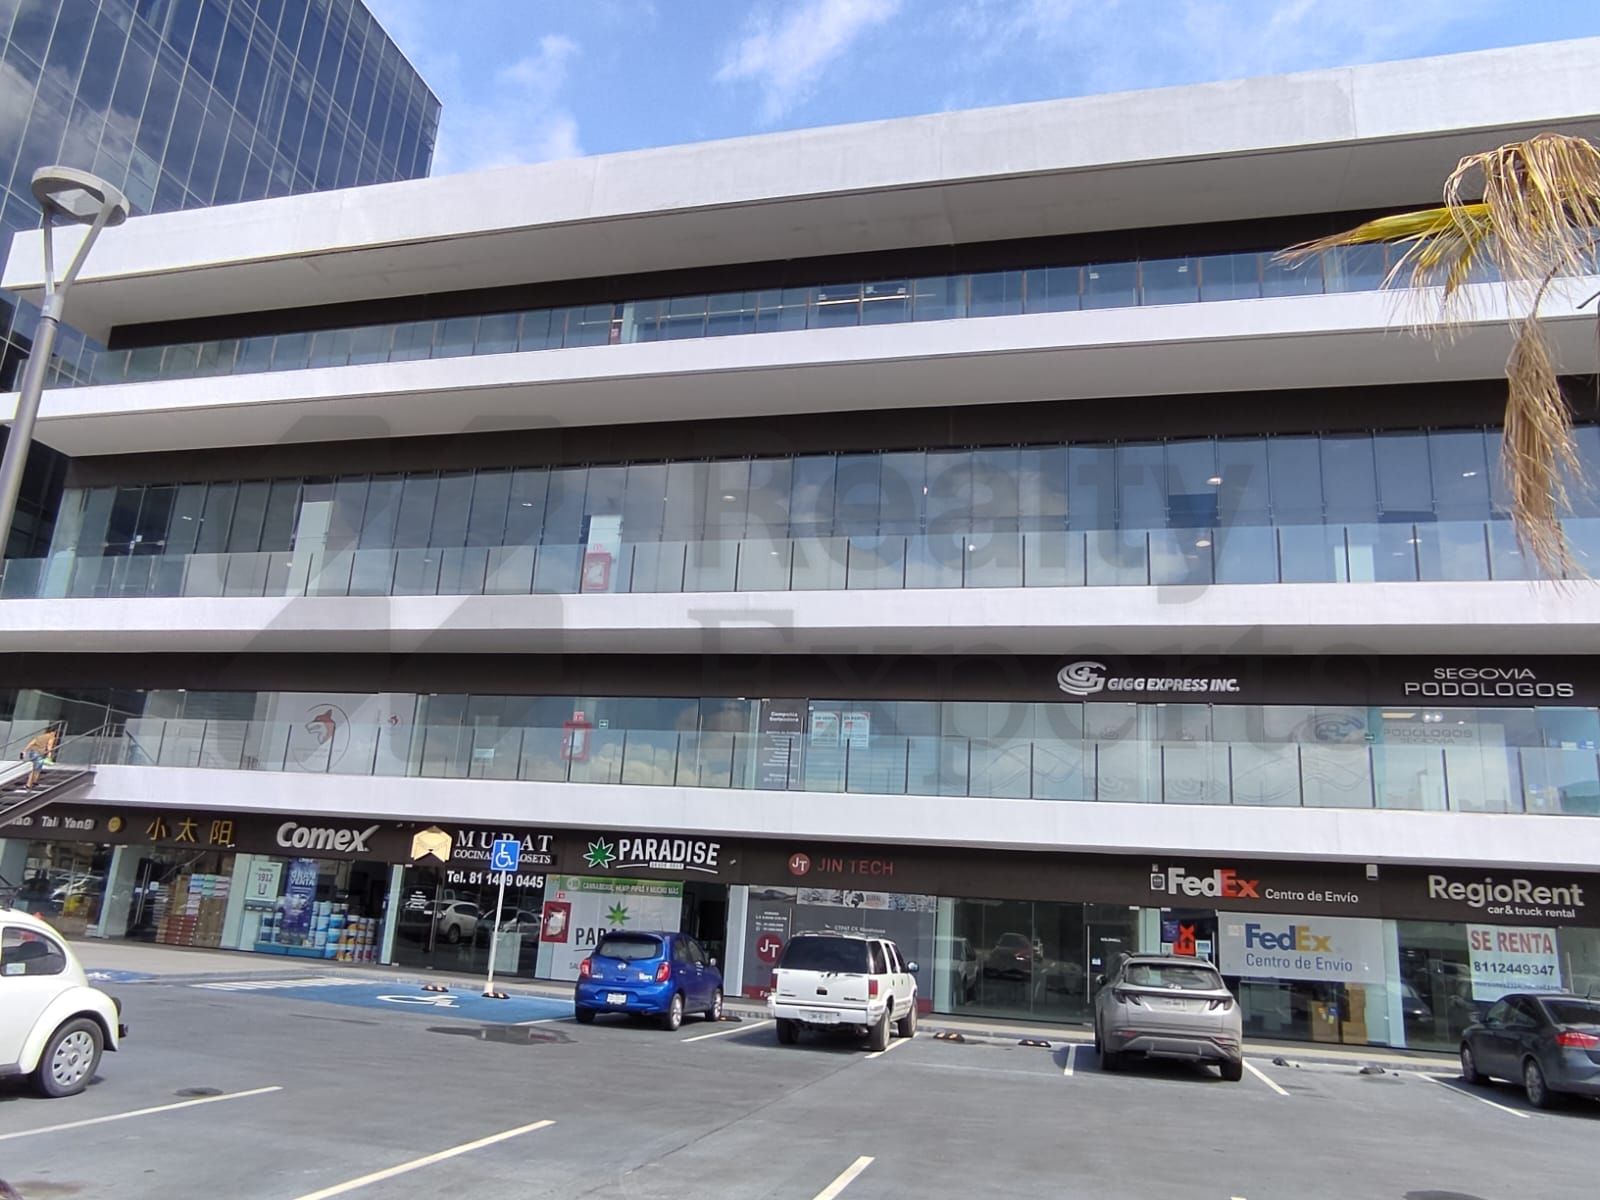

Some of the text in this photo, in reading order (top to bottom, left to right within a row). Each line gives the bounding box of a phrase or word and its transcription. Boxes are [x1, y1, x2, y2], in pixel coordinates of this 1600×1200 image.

[1433, 668, 1536, 680] SEGOVIA
[1107, 677, 1240, 692] GIGG EXPRESS INC.
[1404, 682, 1575, 697] PODOLOGOS
[42, 816, 60, 827] Tai
[65, 816, 95, 830] Yang
[146, 817, 233, 845] 小太阳
[276, 822, 380, 852] Comex
[454, 849, 551, 864] COCINA OSETS
[619, 838, 720, 866] PARADISE
[818, 857, 894, 876] JIN TECH
[447, 871, 544, 889] Tel. 81 149 0445
[1168, 867, 1260, 898] FedEx
[1264, 888, 1304, 901] Centro
[1306, 890, 1322, 902] de
[1428, 875, 1585, 908] RegioRent
[1515, 907, 1543, 917] truck
[1545, 908, 1577, 918] rental
[1245, 923, 1333, 952] FedEx
[1471, 930, 1554, 954] SE RENTA
[1246, 953, 1290, 969] Centro
[1295, 955, 1312, 969] de
[1474, 961, 1555, 976] 8112449347
